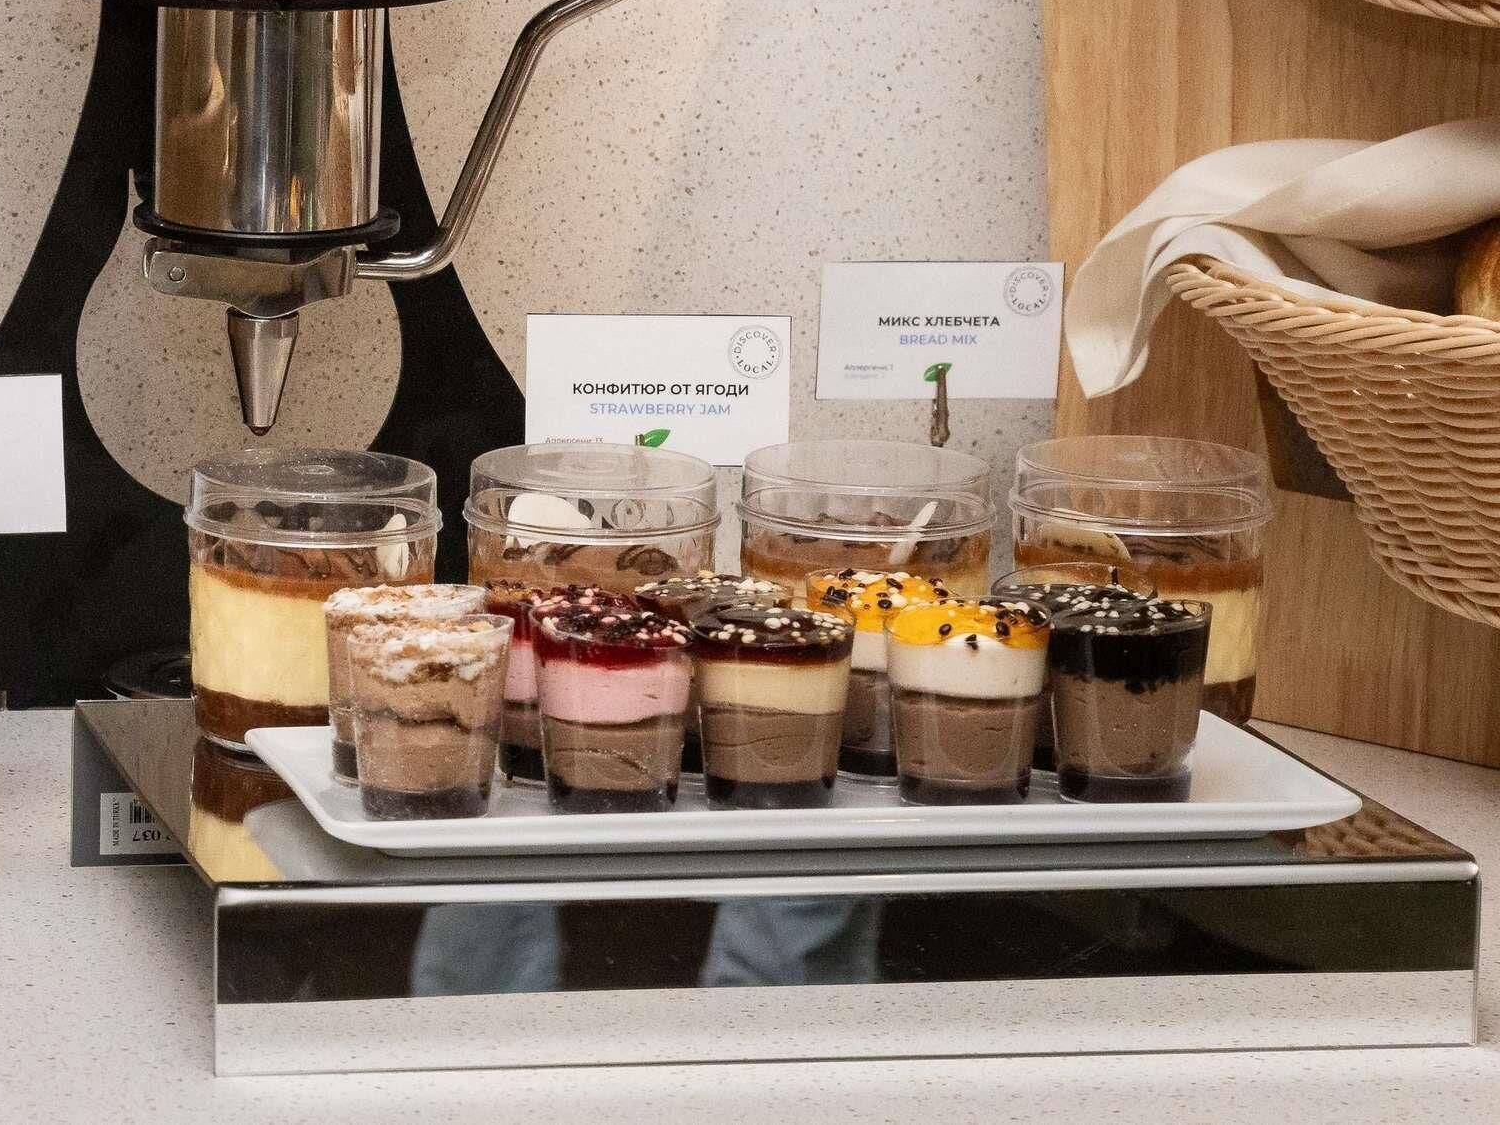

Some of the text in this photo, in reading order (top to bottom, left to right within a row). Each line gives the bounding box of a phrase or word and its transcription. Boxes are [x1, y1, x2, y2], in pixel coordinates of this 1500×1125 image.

[1009, 270, 1050, 293] DISCOVER
[878, 315, 1000, 327] МИКС ХЛЕБЧЕТА
[733, 330, 778, 355] DISCOVER
[899, 334, 978, 345] BREAD MIX
[736, 358, 776, 374] LOCAL
[572, 382, 749, 399] КОНФИТЮР ОТ ЯГОДИ
[589, 402, 731, 416] STRAWBERRY JAM
